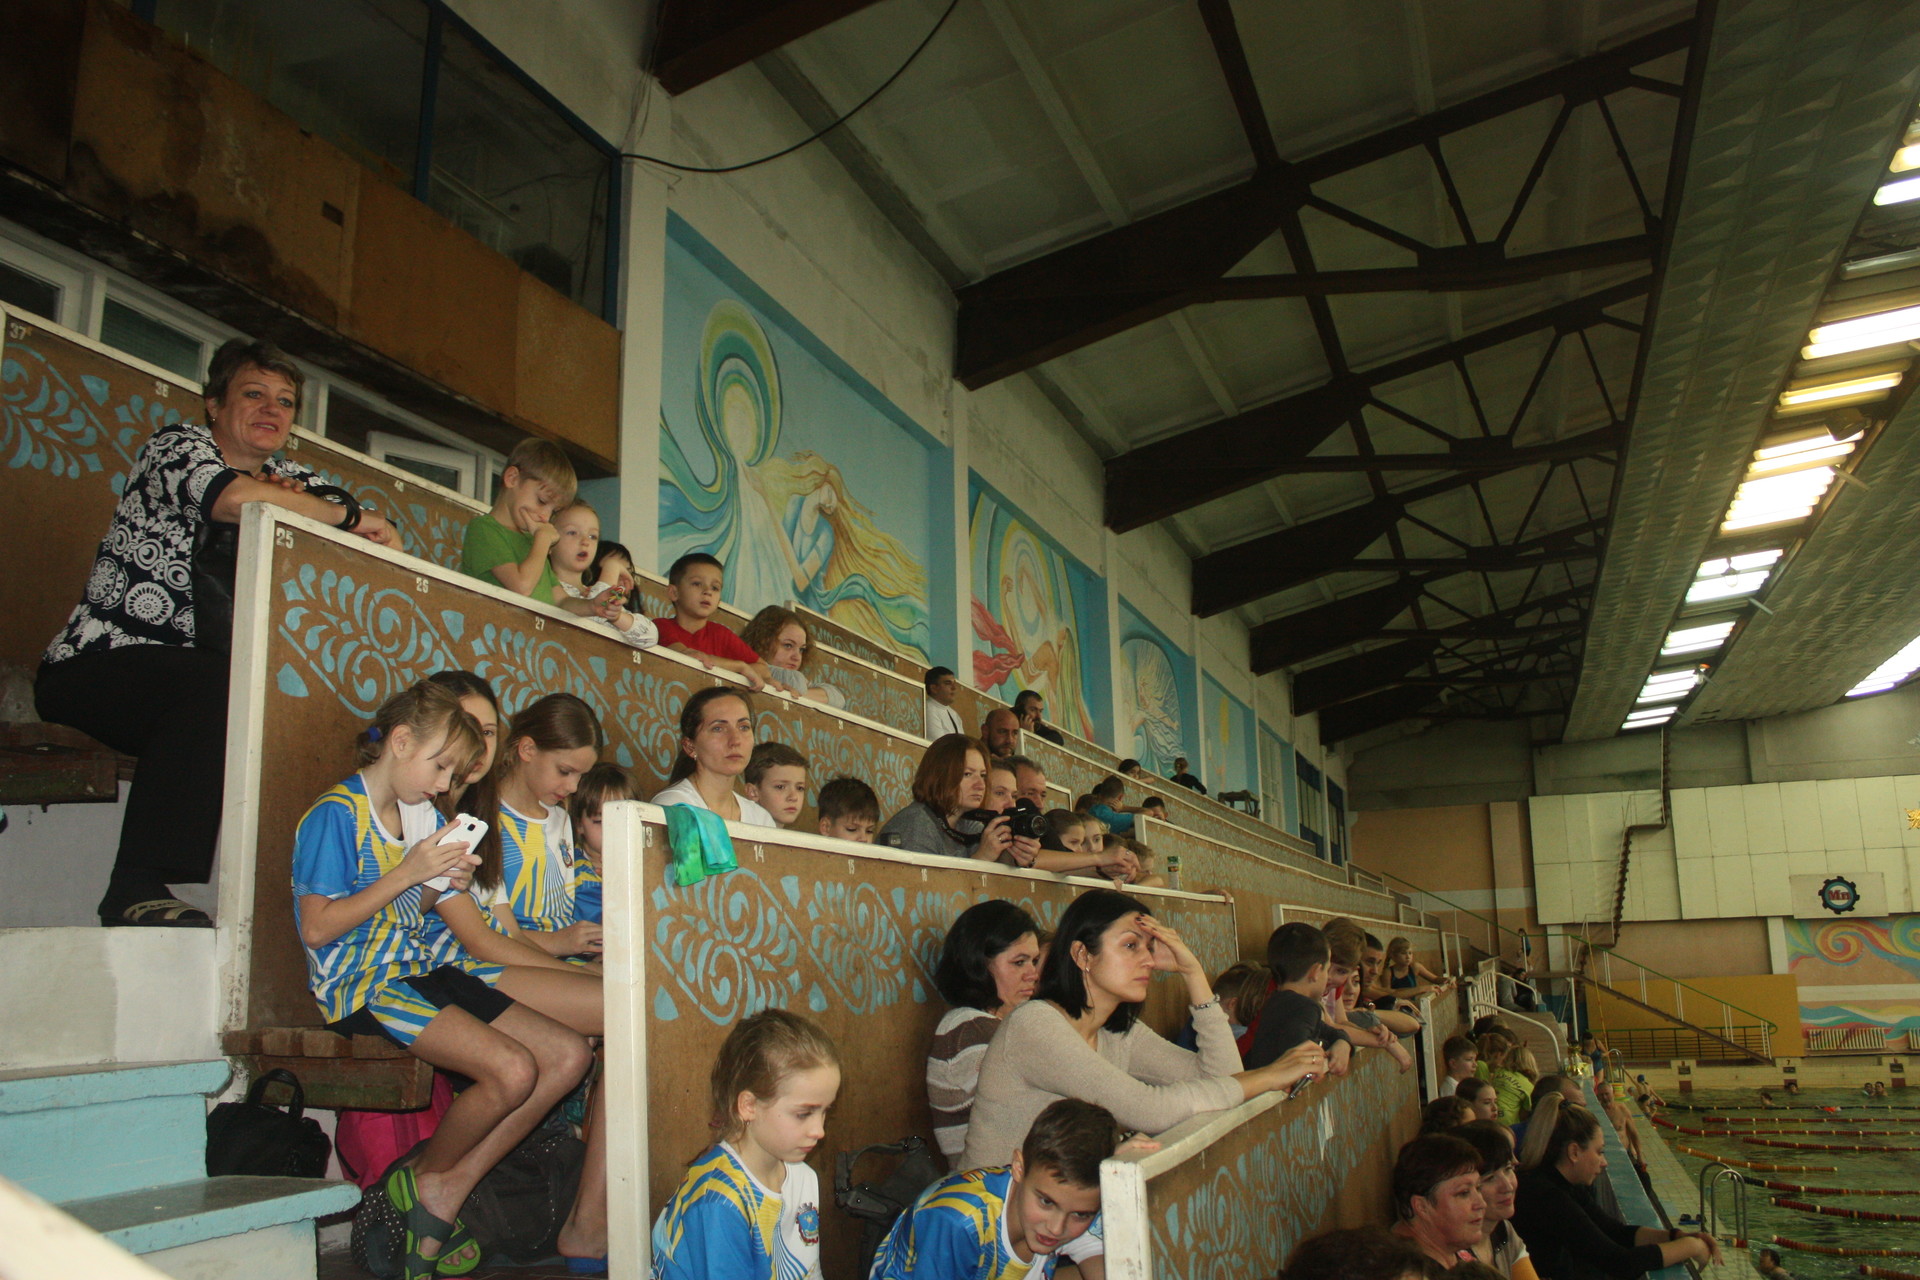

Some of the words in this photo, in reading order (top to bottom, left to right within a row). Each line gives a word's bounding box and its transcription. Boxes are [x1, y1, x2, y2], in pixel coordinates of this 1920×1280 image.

[276, 527, 294, 549] 25
[416, 576, 429, 594] 26
[535, 616, 545, 631] 27
[753, 844, 765, 863] 14
